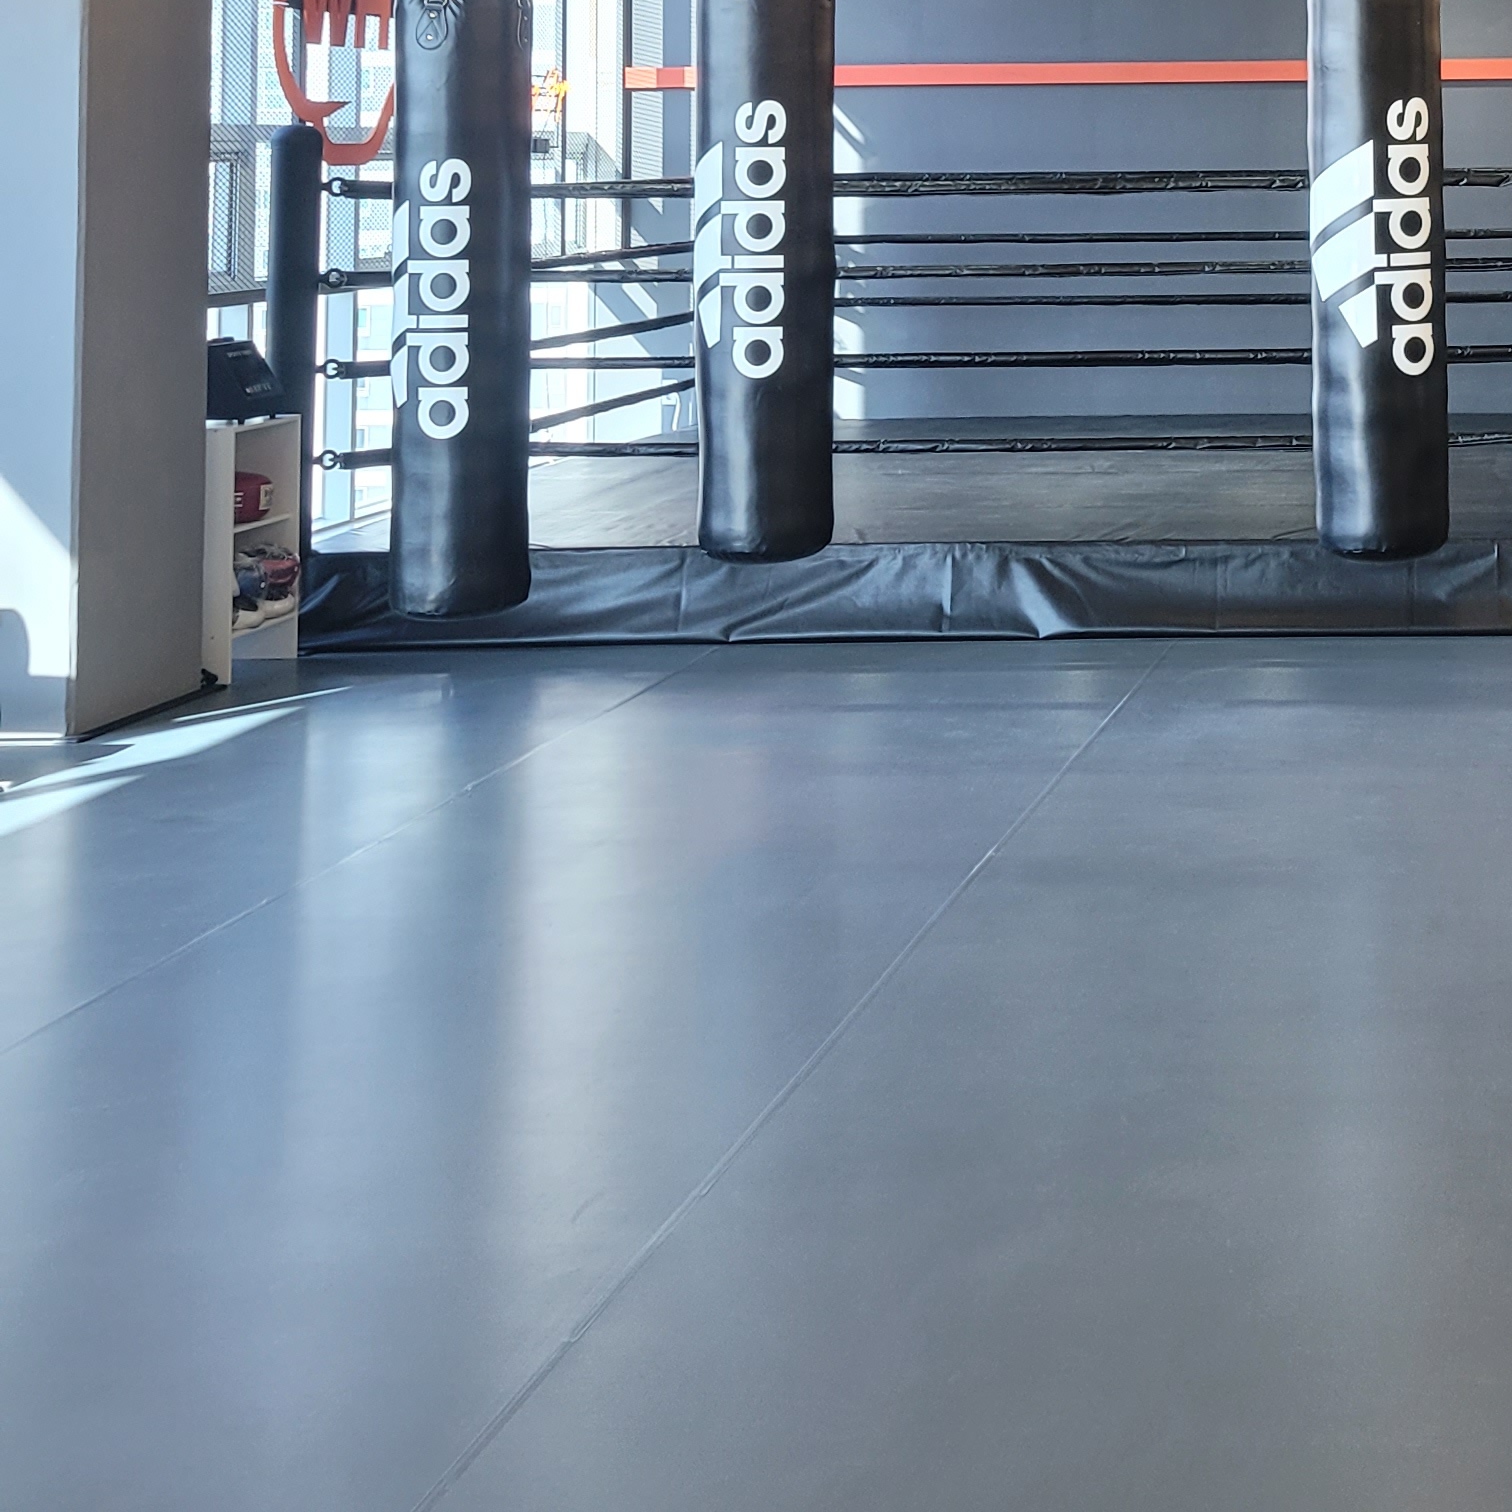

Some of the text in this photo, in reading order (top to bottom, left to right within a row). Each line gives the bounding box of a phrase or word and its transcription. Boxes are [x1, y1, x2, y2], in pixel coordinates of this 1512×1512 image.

[407, 158, 472, 440] adidas
[721, 99, 788, 379] adidas
[1372, 96, 1435, 377] adidas
